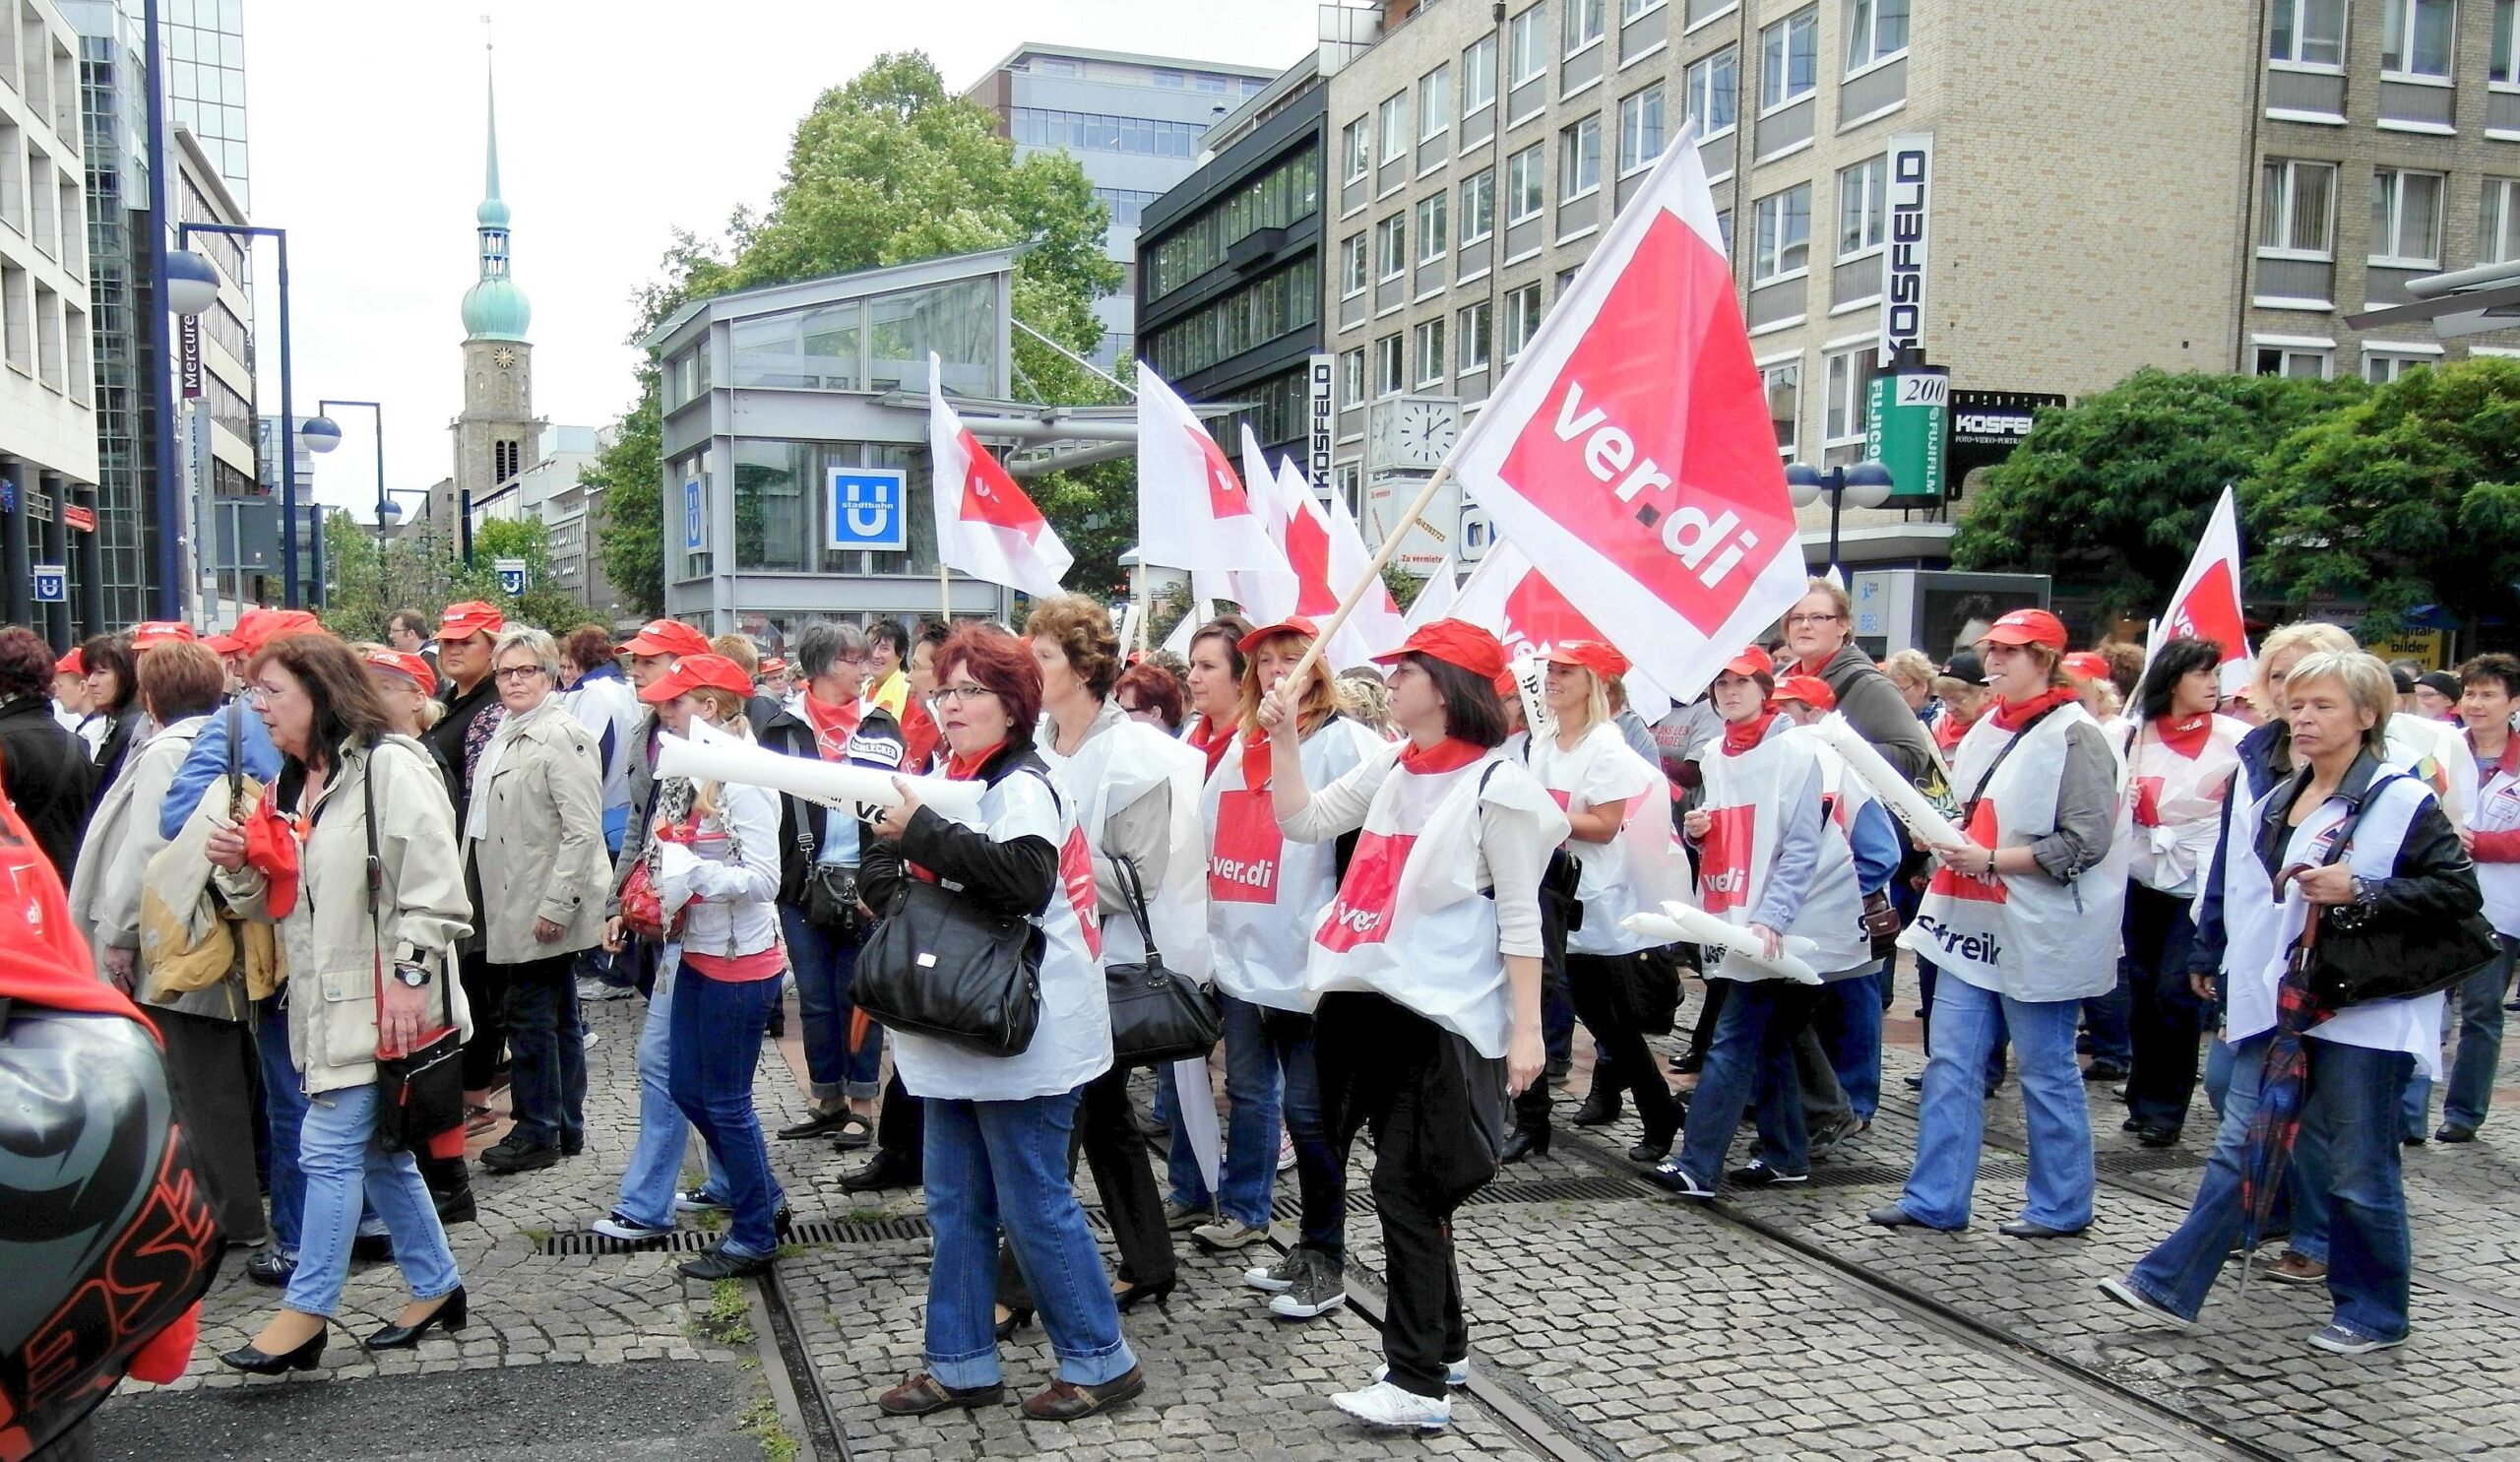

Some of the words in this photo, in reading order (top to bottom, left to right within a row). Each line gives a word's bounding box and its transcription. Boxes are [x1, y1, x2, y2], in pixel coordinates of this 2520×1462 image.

[183, 314, 199, 389] Mercure
[1904, 378, 1946, 402] 200
[1313, 363, 1331, 489] KOSFELD
[1925, 421, 1938, 493] FUJIFILM
[842, 500, 894, 510] stadtbahn
[1553, 380, 1759, 590] ver.di
[2390, 640, 2430, 653] bilder
[1213, 856, 1274, 888] ver.di
[1917, 915, 2002, 966] Streik
